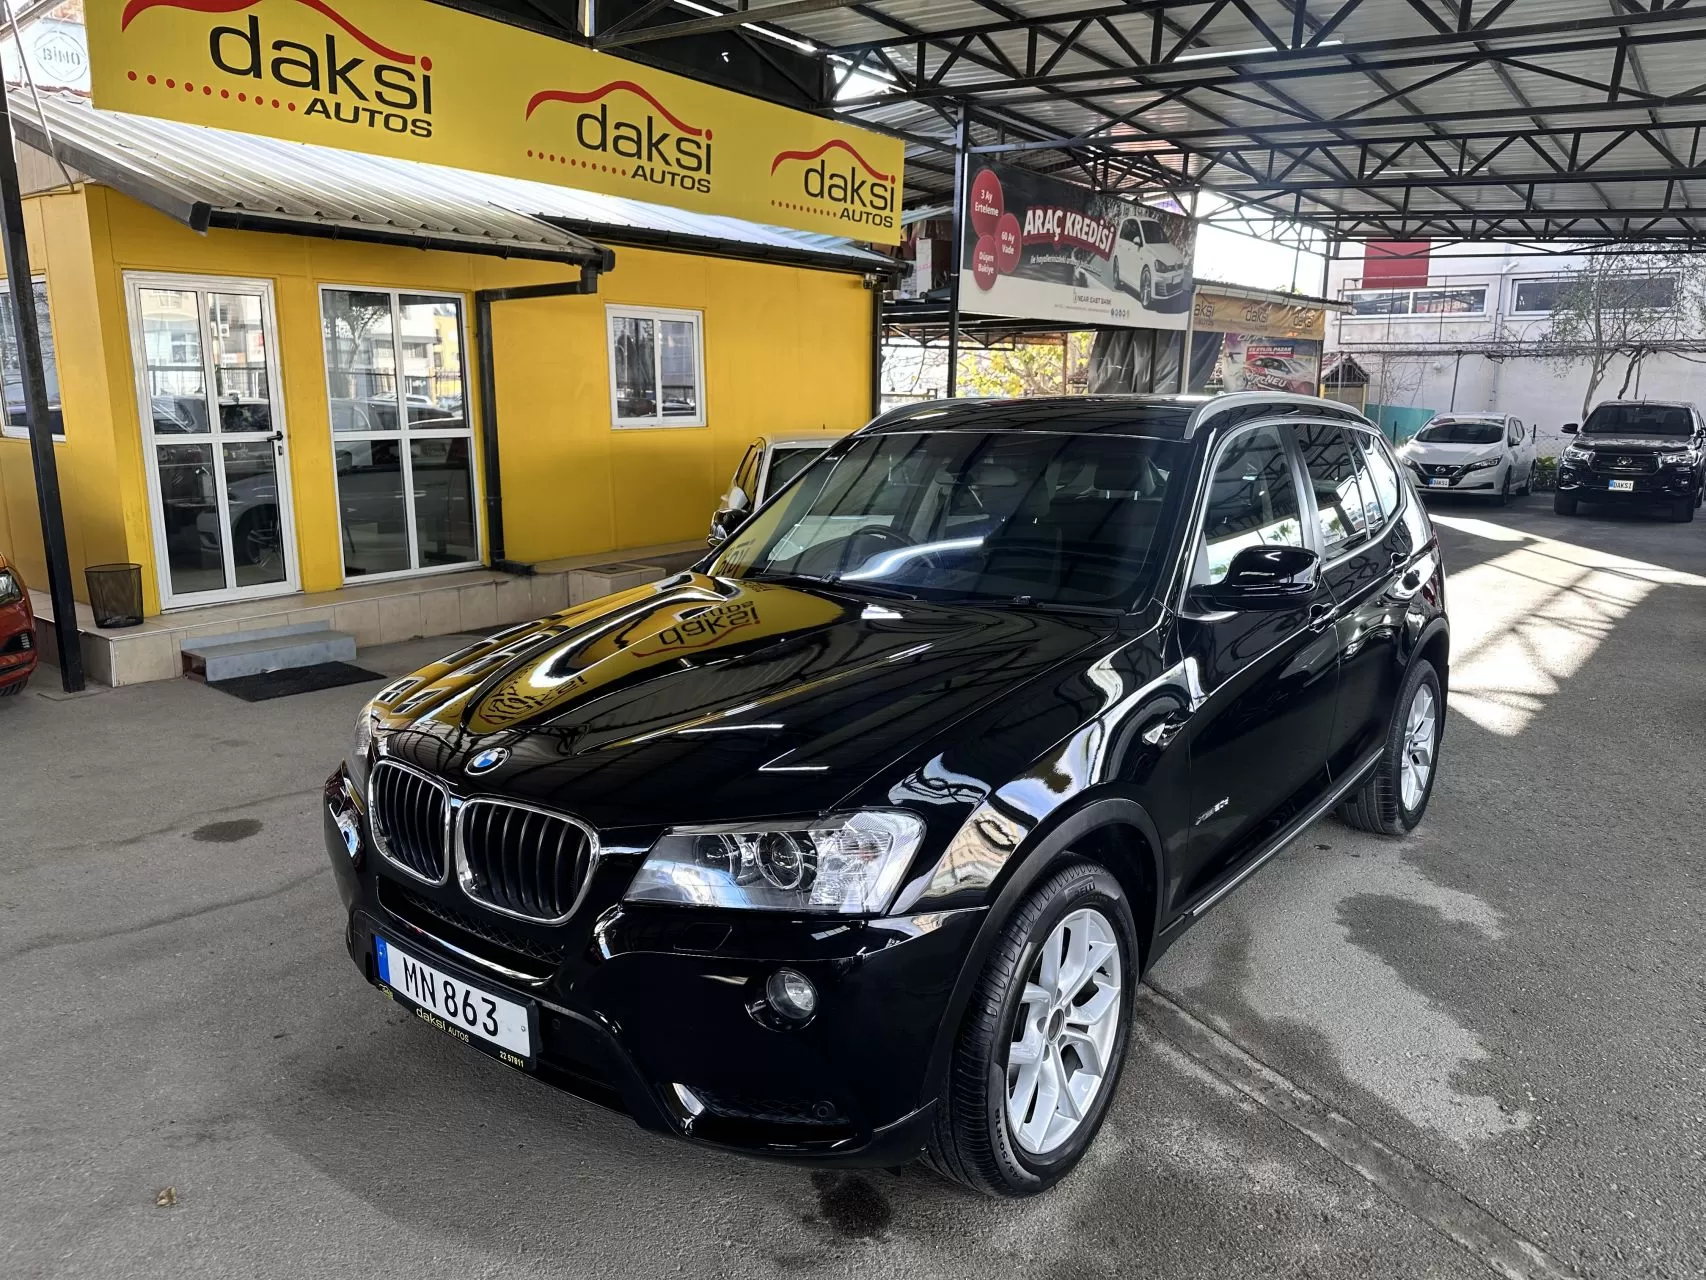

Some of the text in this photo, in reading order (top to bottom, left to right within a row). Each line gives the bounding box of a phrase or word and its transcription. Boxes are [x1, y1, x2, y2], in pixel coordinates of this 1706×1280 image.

[209, 14, 433, 115] daksi
[303, 96, 433, 139] AUTOS
[576, 103, 713, 175] daksi
[631, 164, 711, 194] AUTOS
[804, 159, 896, 213] daksi
[980, 189, 993, 204] 3 Ay
[839, 207, 894, 229] AUTOS
[1023, 209, 1114, 253] ARAÇ KREDİSİ
[402, 955, 500, 1037] MN 863
[415, 1007, 470, 1043] daksi AUTOS
